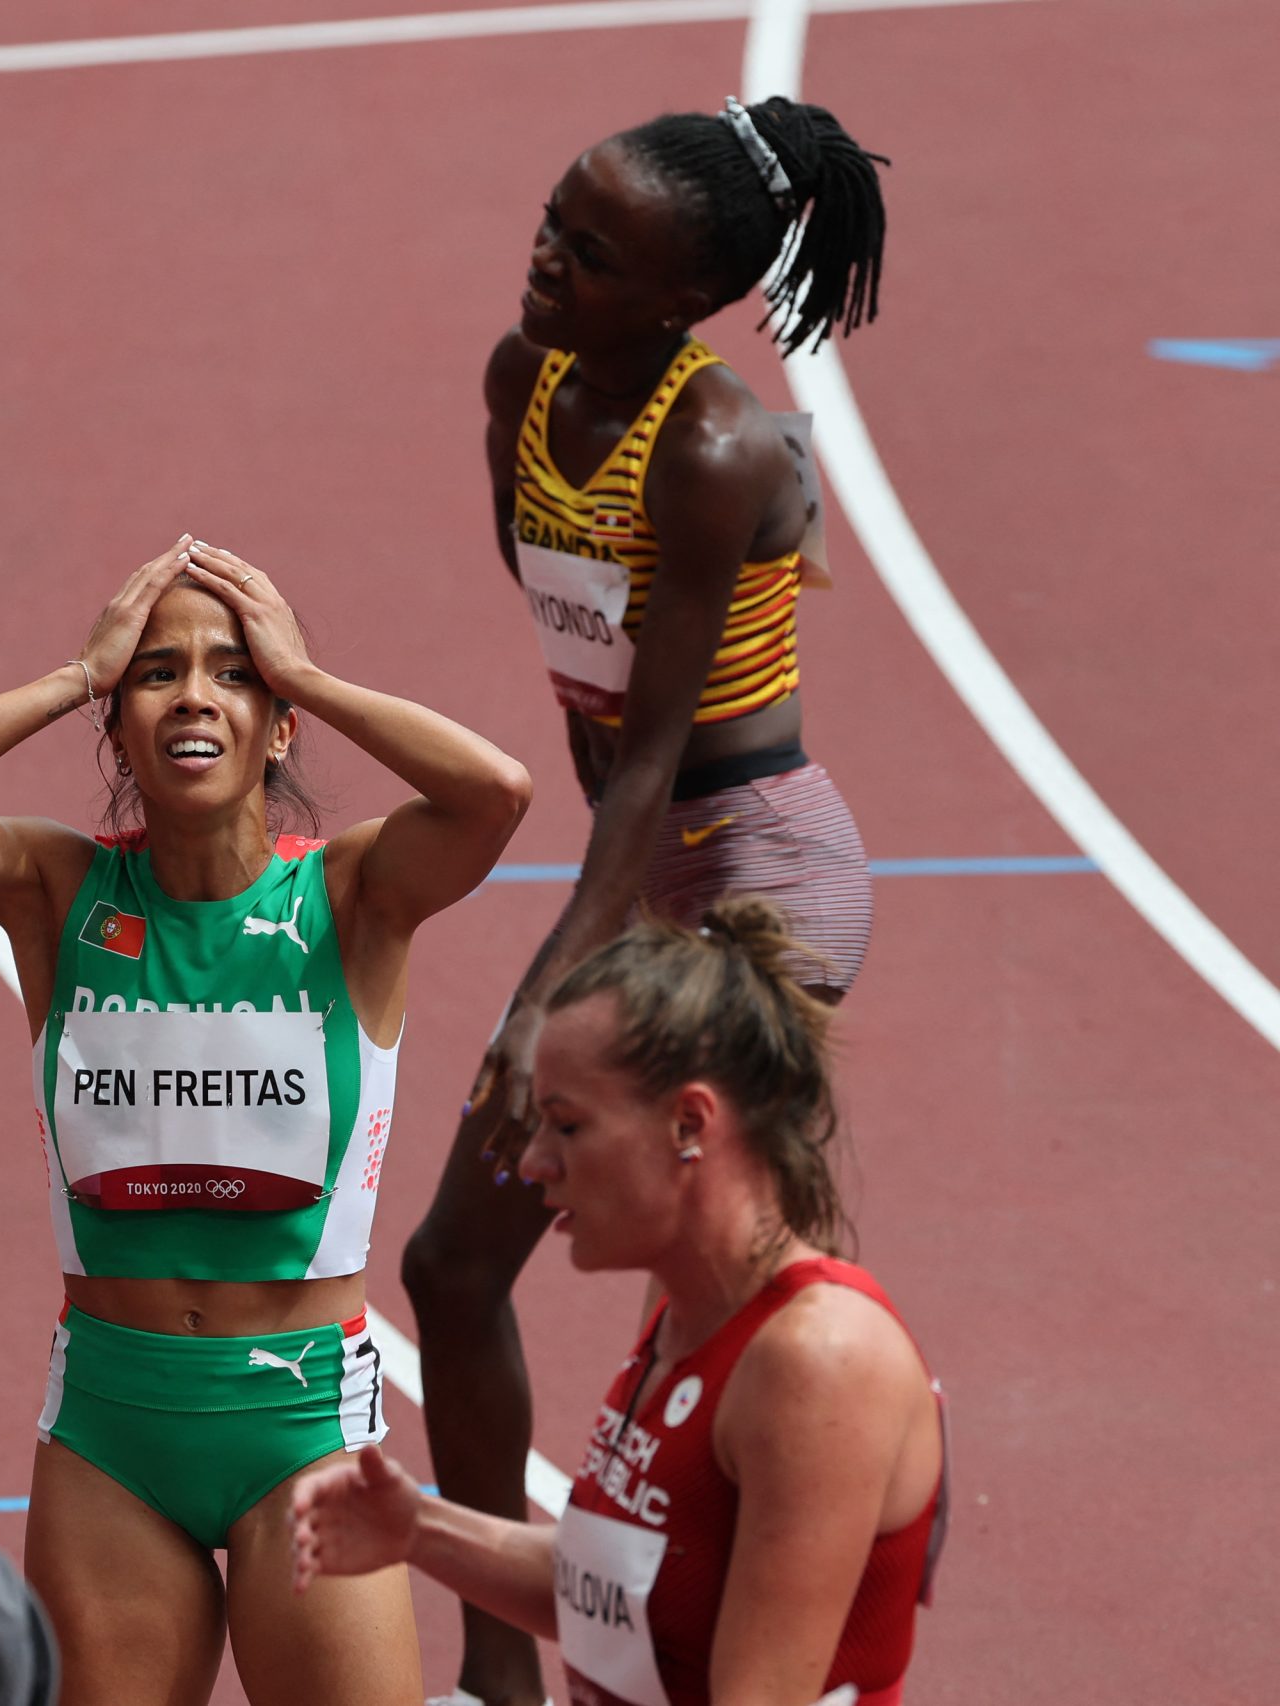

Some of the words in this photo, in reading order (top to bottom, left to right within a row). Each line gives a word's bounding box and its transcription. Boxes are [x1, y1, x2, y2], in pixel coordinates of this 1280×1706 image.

[74, 1069, 135, 1106] PEN
[153, 1069, 306, 1107] FREITAS
[126, 1183, 168, 1195] TOKYO
[170, 1182, 201, 1195] 2020
